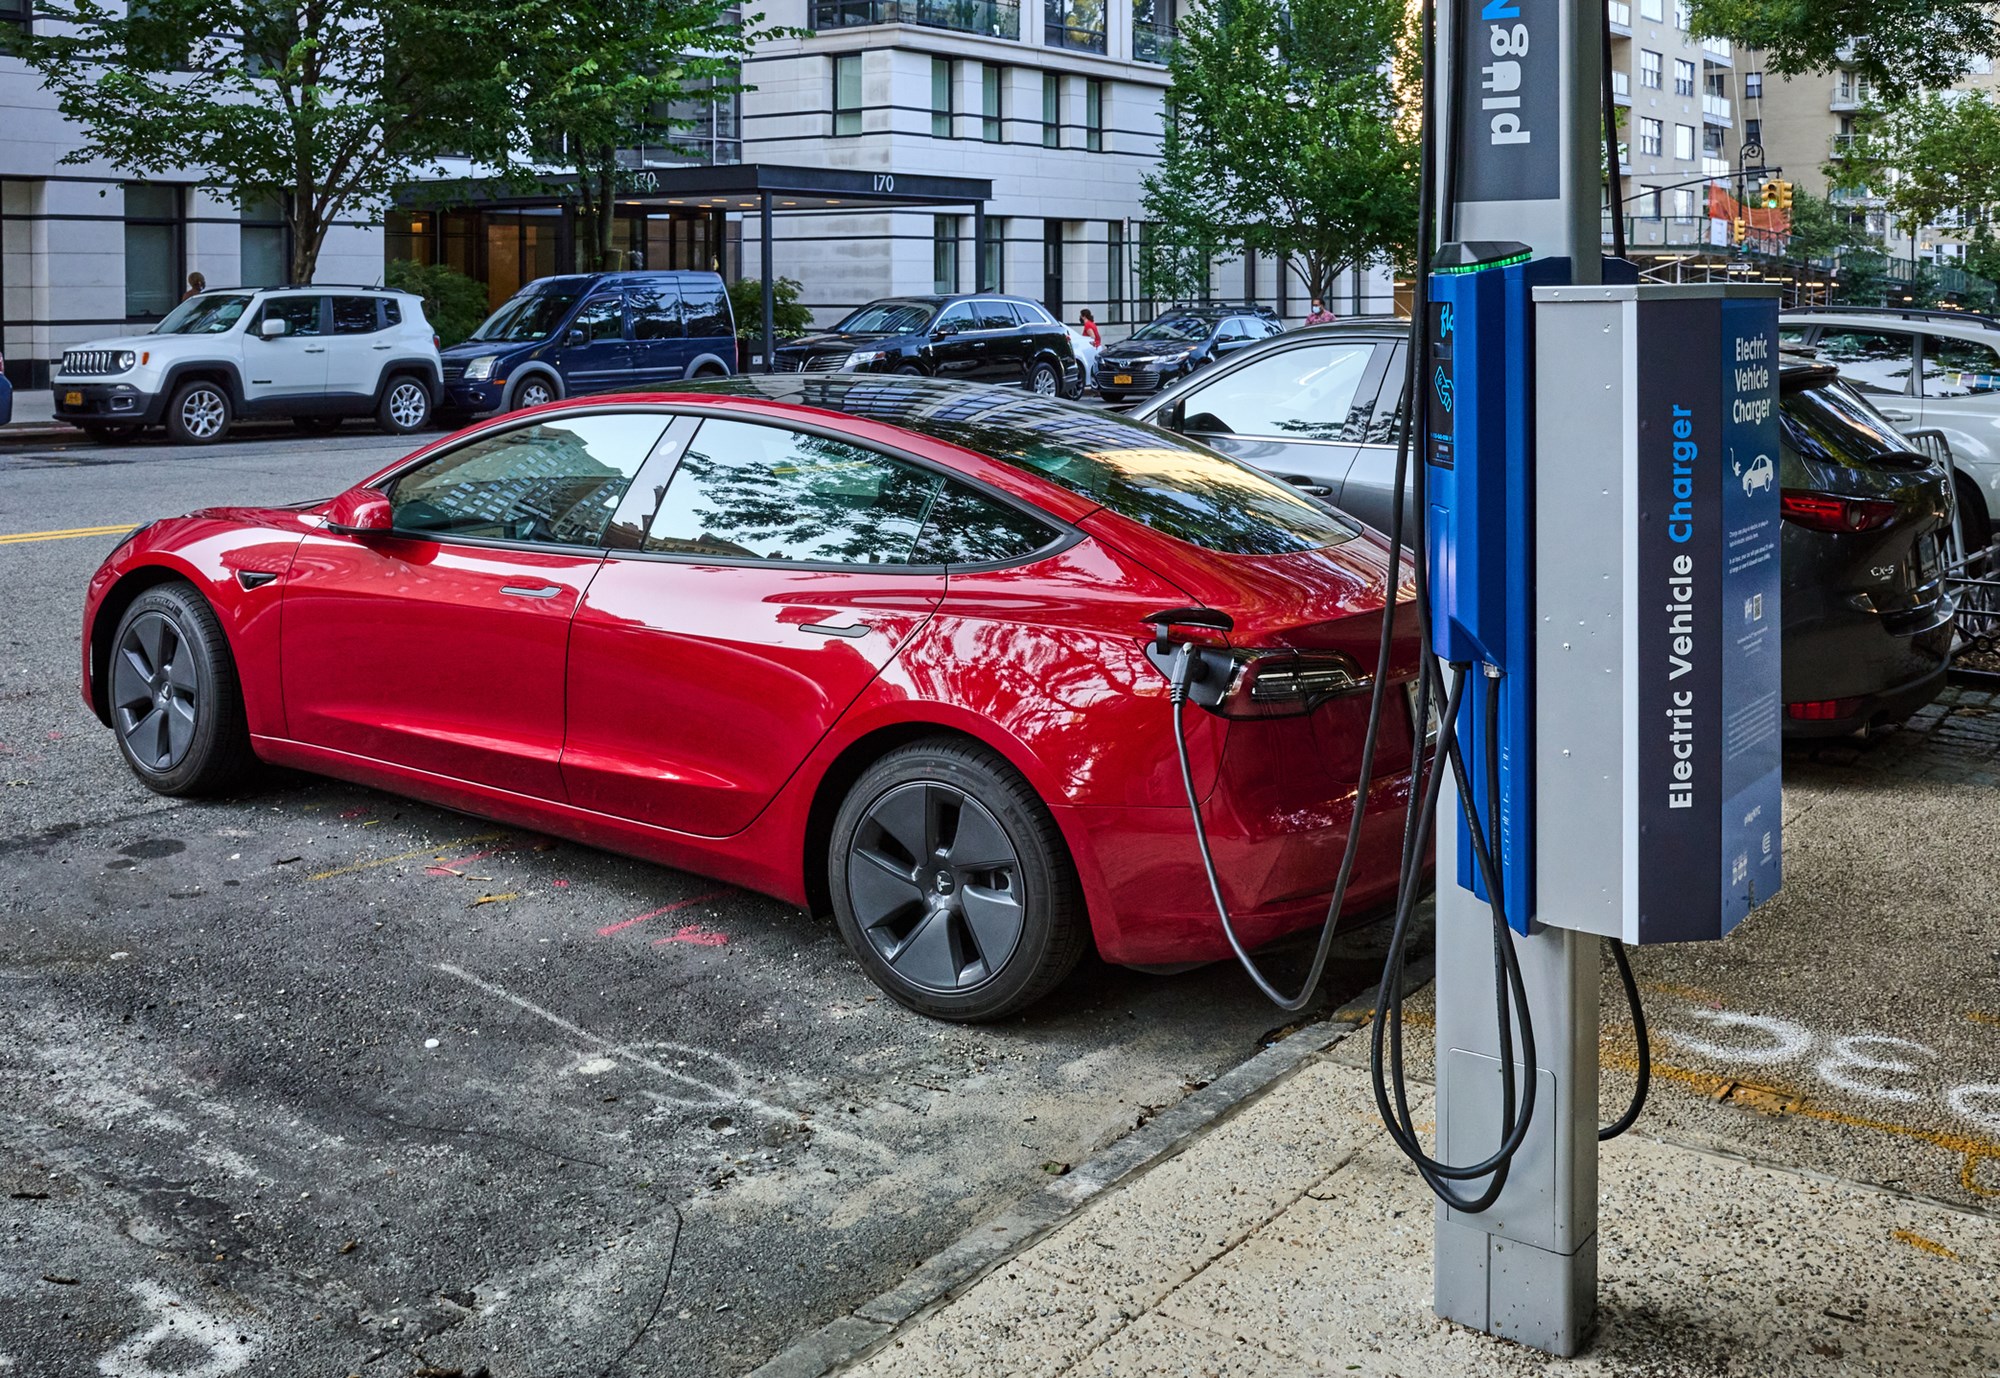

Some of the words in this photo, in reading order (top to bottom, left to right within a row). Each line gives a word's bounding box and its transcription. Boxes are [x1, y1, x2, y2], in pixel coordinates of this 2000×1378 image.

[873, 174, 894, 192] 170
[1735, 332, 1768, 362] Electric
[1734, 363, 1769, 393] Vehicle
[1732, 398, 1771, 425] Charger
[1668, 404, 1698, 543] Charger
[1870, 564, 1895, 577] CX-5
[1666, 554, 1693, 681] Vehicle
[1666, 691, 1693, 808] Electric
